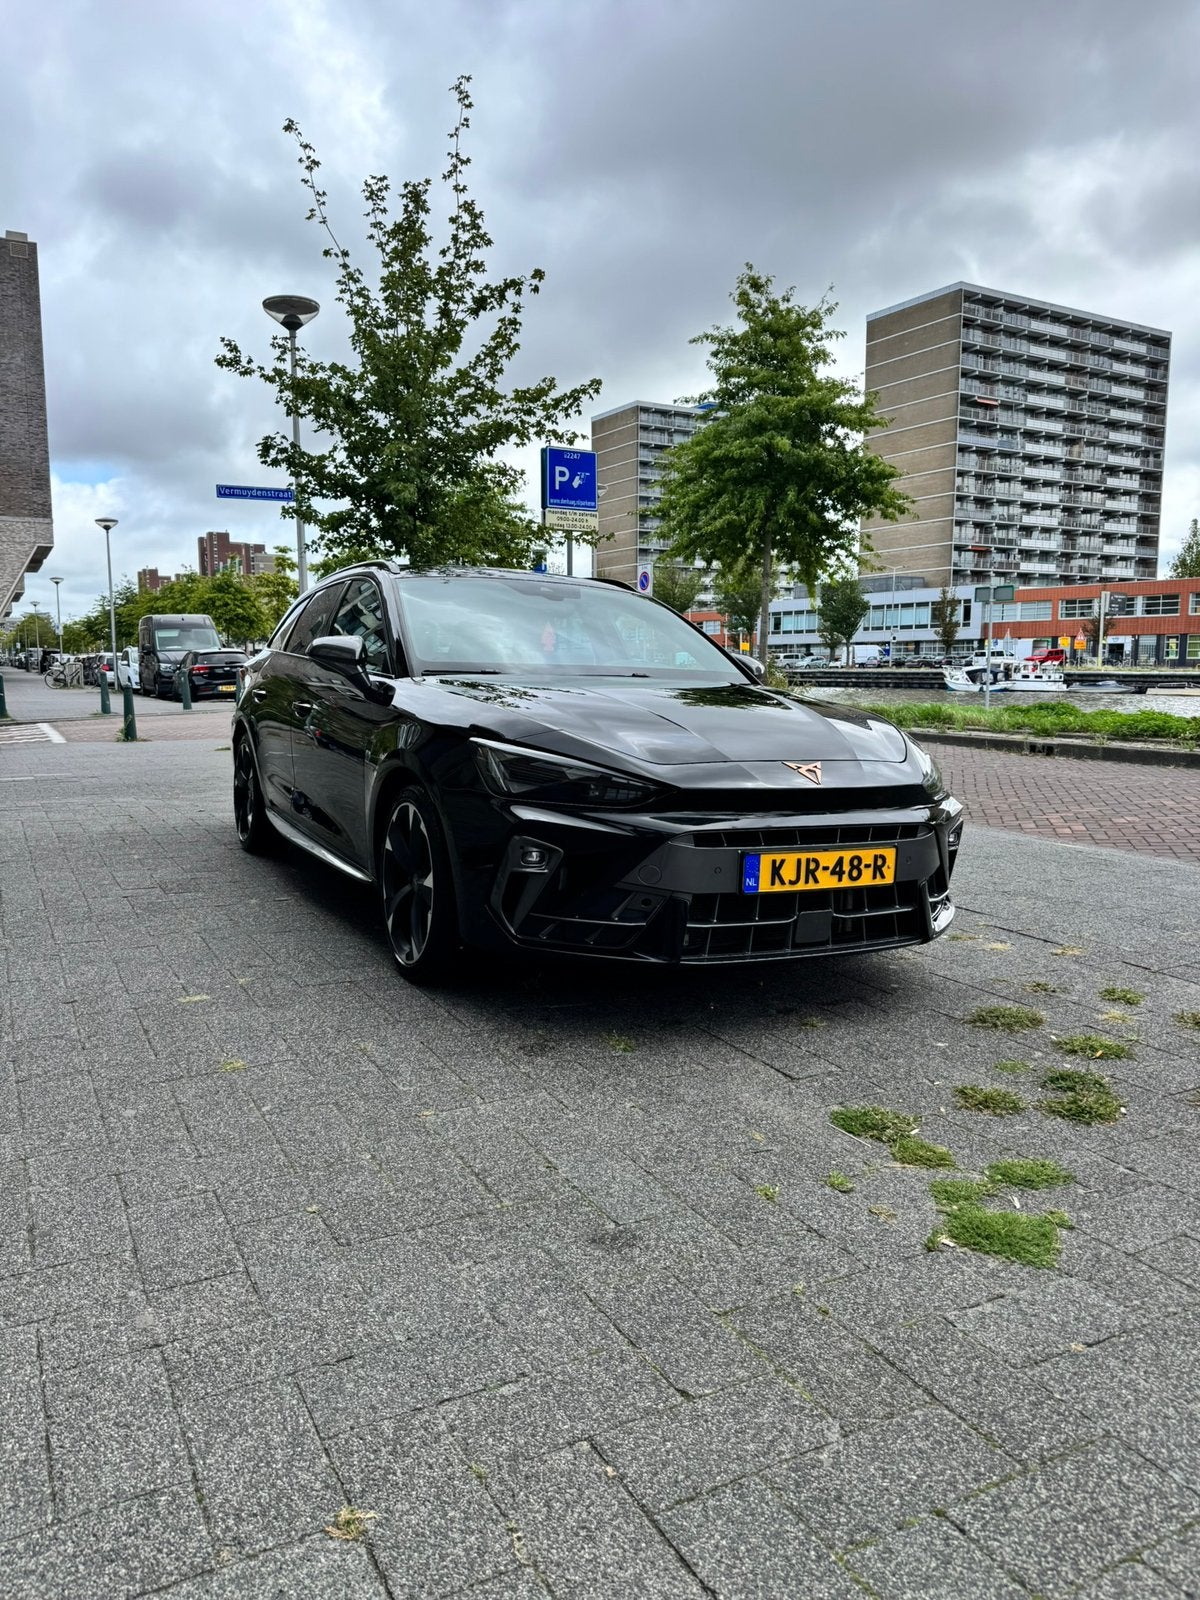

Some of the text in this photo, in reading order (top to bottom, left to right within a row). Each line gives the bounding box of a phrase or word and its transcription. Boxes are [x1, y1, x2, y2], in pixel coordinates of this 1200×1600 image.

[555, 466, 570, 490] P
[219, 487, 292, 498] Vermuydenstraat
[770, 853, 887, 887] KJR-48-R
[745, 878, 757, 887] NL
